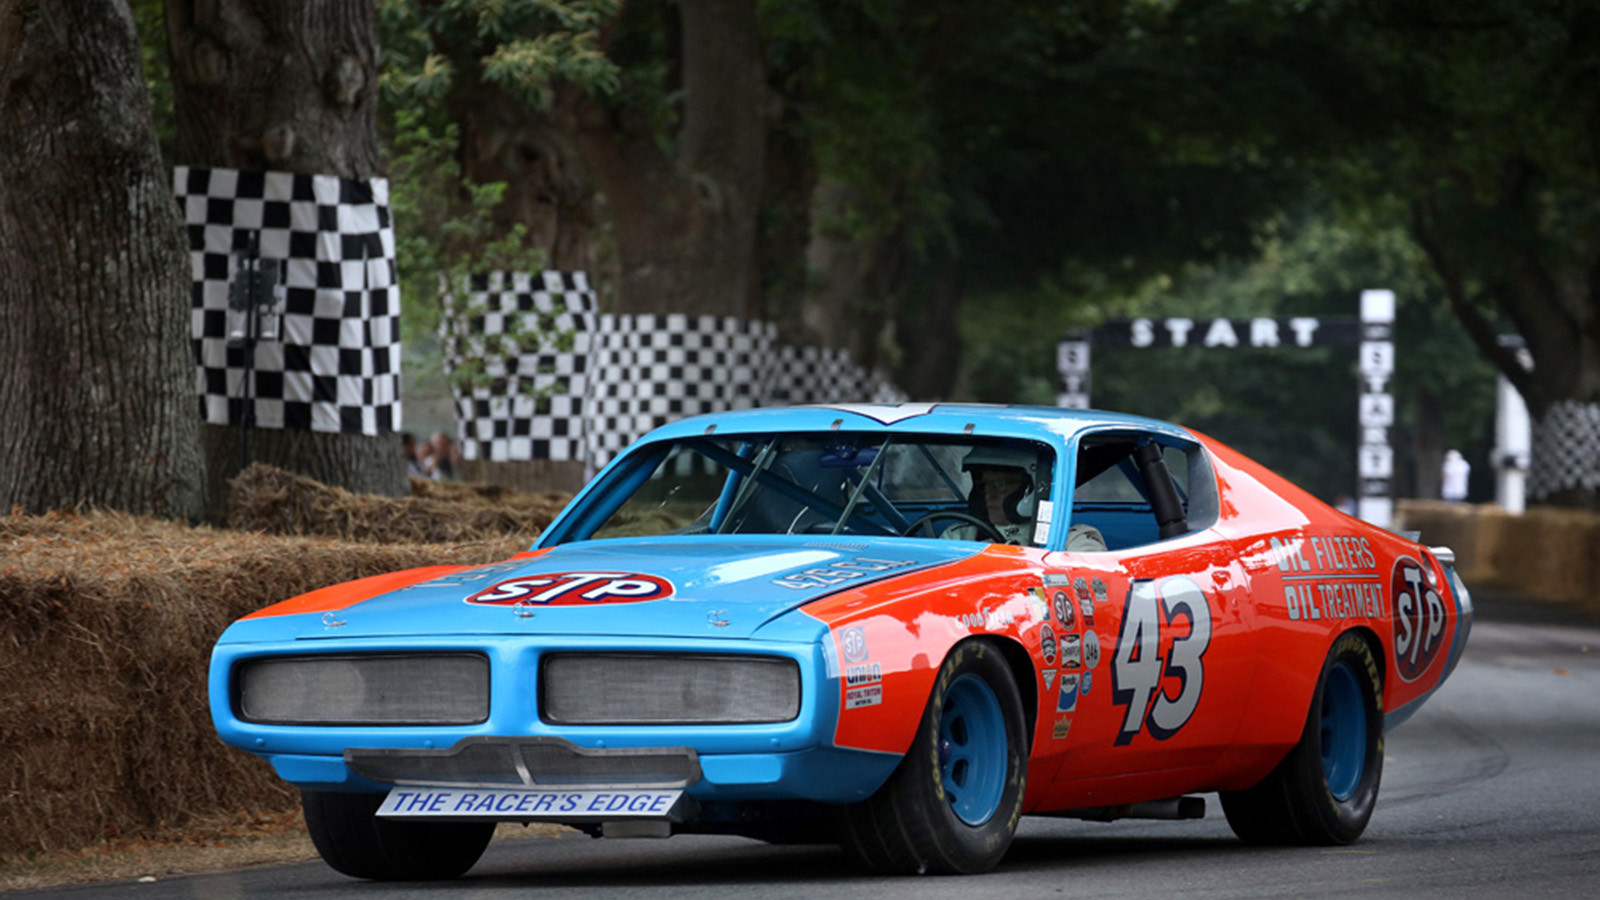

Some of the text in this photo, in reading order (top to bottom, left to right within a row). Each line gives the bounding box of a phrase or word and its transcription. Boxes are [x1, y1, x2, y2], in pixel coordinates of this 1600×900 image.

[1130, 317, 1320, 348] START
[1270, 536, 1377, 572] OIL FILTERS
[475, 573, 661, 603] STP
[771, 568, 867, 589] 426
[1055, 594, 1073, 622] STP
[1284, 583, 1386, 621] OIL TREATMENT
[1396, 566, 1443, 665] STP
[845, 632, 864, 655] STP
[1110, 574, 1212, 747] 43
[392, 793, 672, 812] THE RACER'S EDGE
